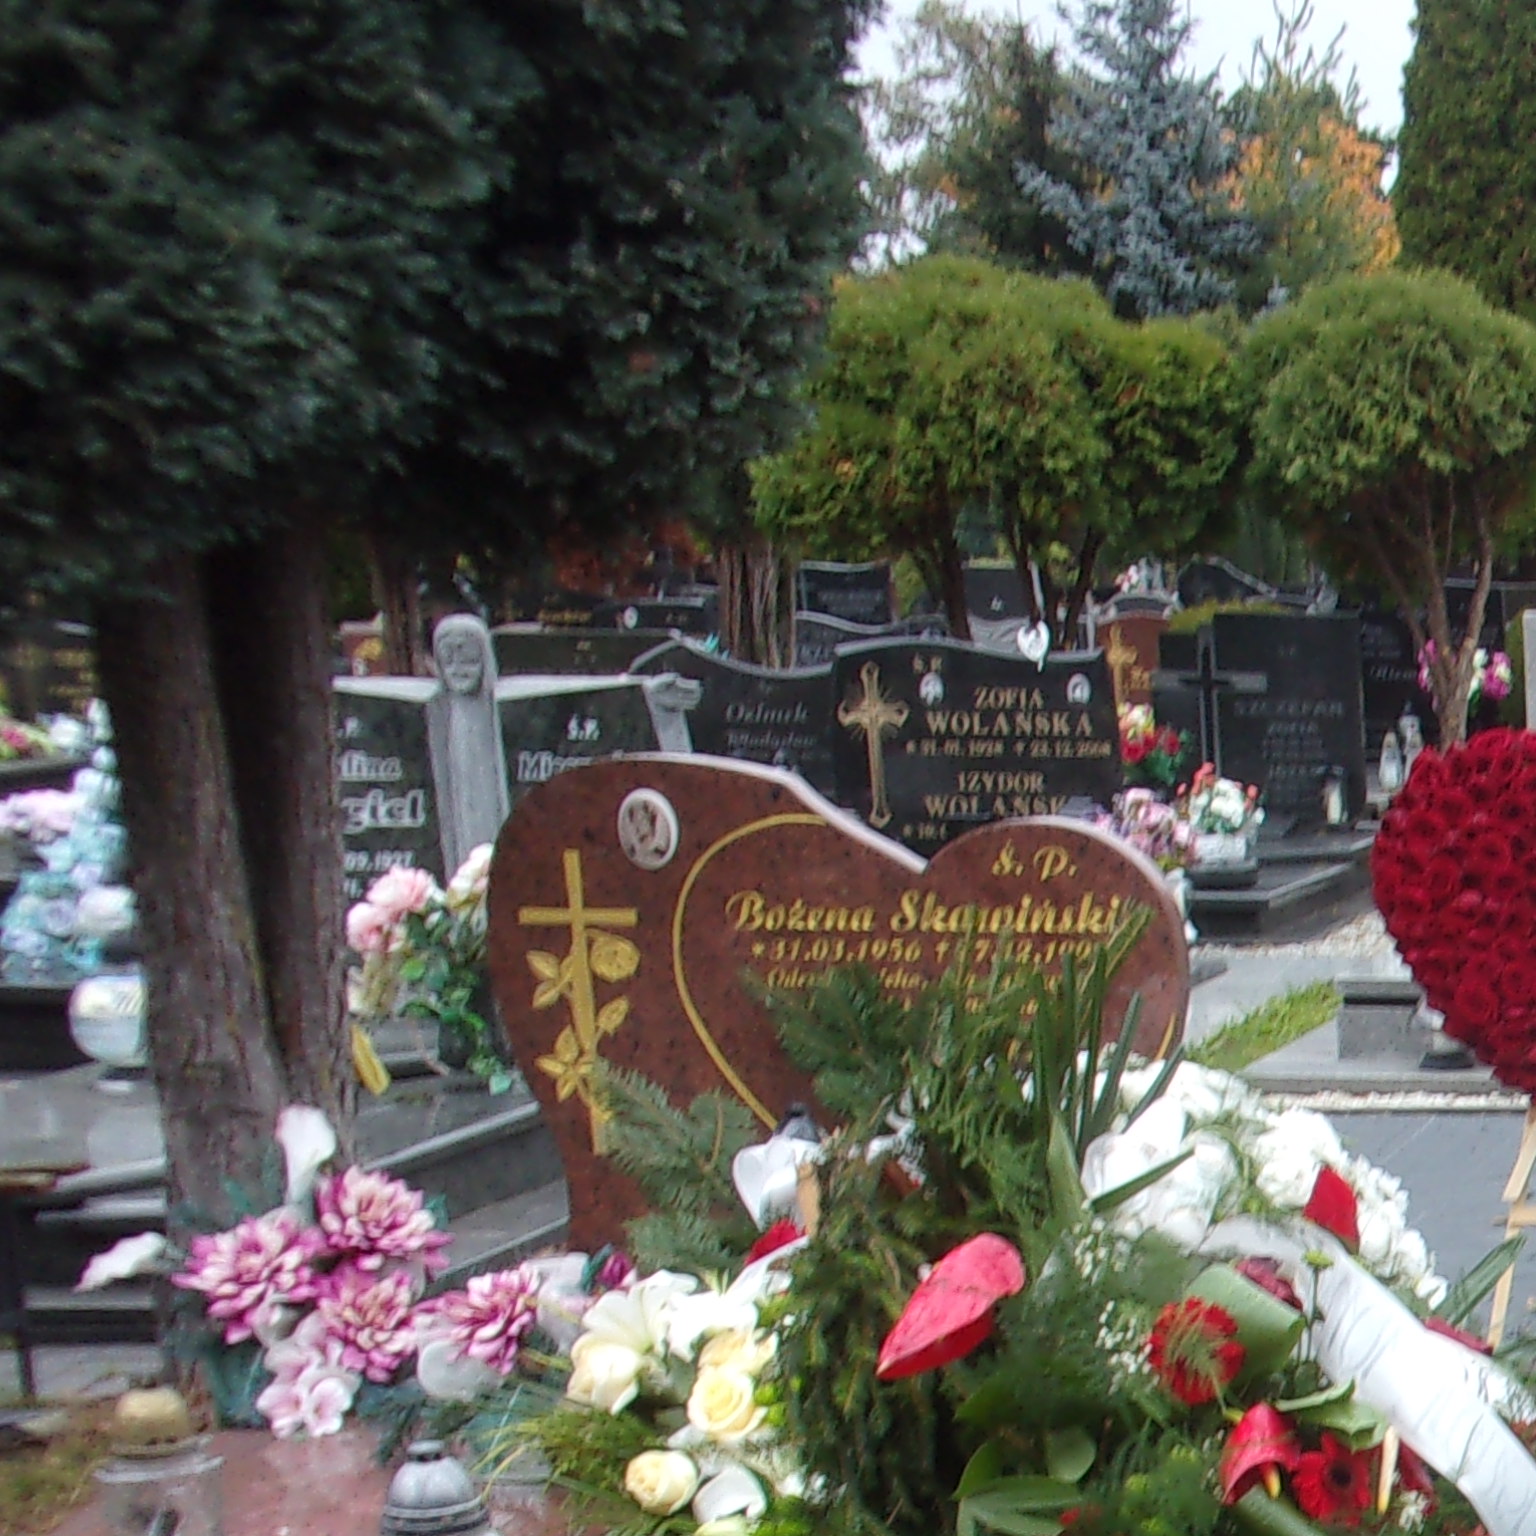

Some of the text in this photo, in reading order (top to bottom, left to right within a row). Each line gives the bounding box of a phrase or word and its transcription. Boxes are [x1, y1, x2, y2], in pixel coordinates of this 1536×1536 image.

[974, 686, 1045, 710] ZOFIA
[926, 708, 1093, 737] WOLAŃSKA
[958, 770, 1045, 793] IZYDOR
[724, 889, 876, 934] Bożena
